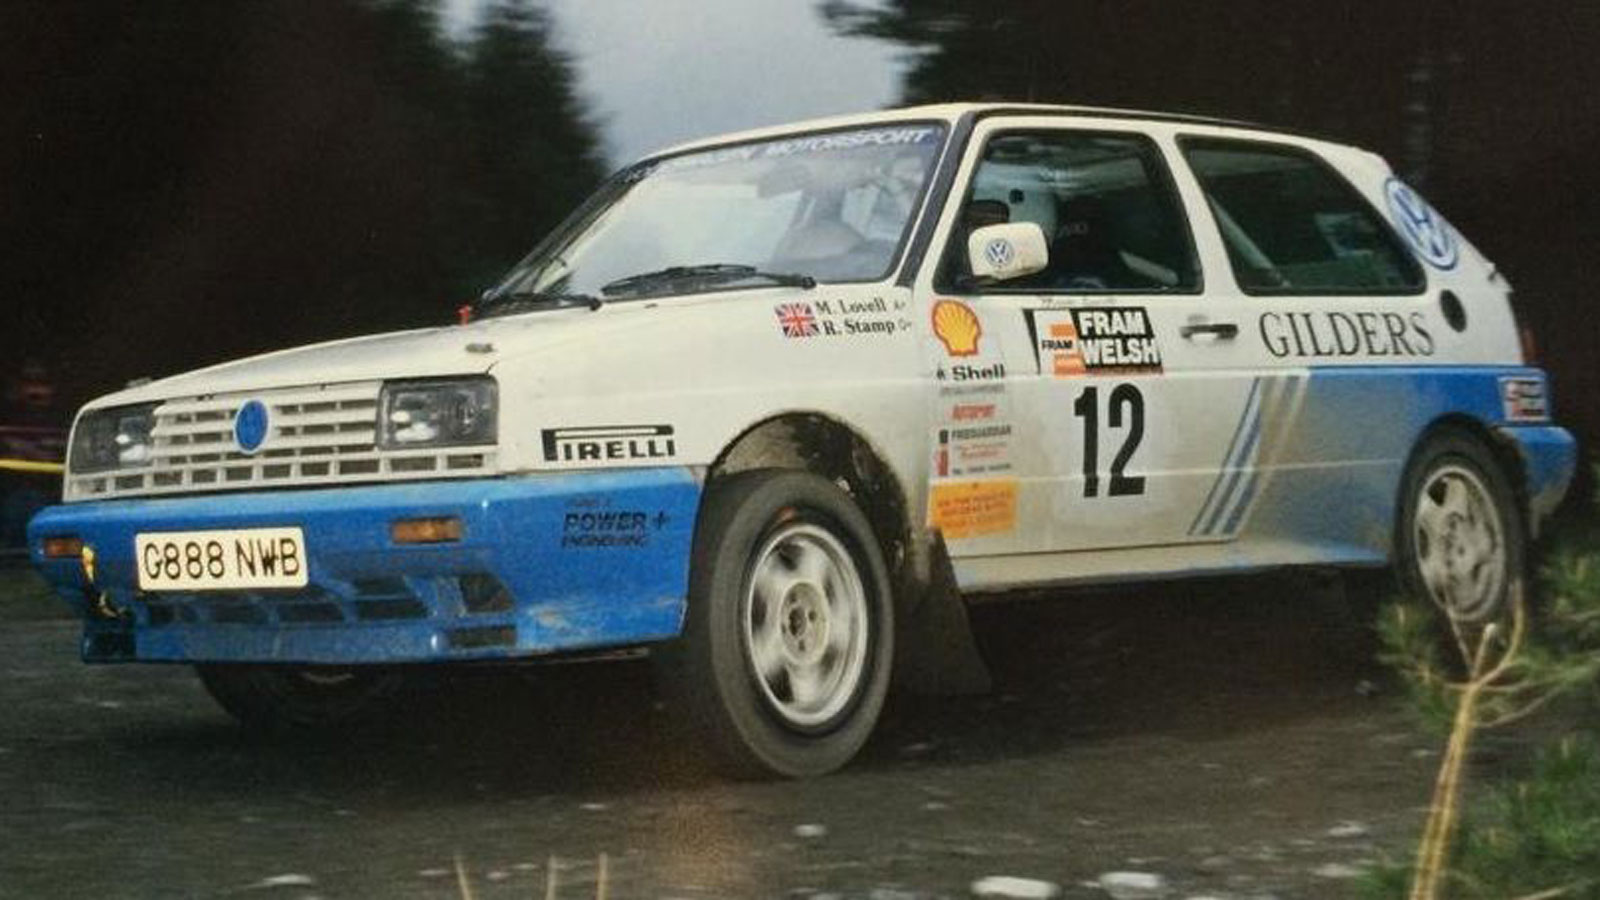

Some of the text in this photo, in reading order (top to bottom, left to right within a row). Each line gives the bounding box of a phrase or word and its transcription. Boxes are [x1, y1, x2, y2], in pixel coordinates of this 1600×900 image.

[840, 297, 886, 314] Lovell
[823, 319, 843, 335] R.
[844, 317, 895, 335] Stamp
[1078, 310, 1146, 336] FRAM
[1259, 312, 1435, 357] GILDERS
[1041, 340, 1073, 350] FRAM
[1080, 338, 1160, 365] WELSH
[952, 363, 1006, 381] Shell
[541, 424, 676, 462] PIRELLI
[1074, 383, 1146, 498] 12
[563, 511, 647, 531] POWER
[144, 538, 299, 579] G888 NWB
